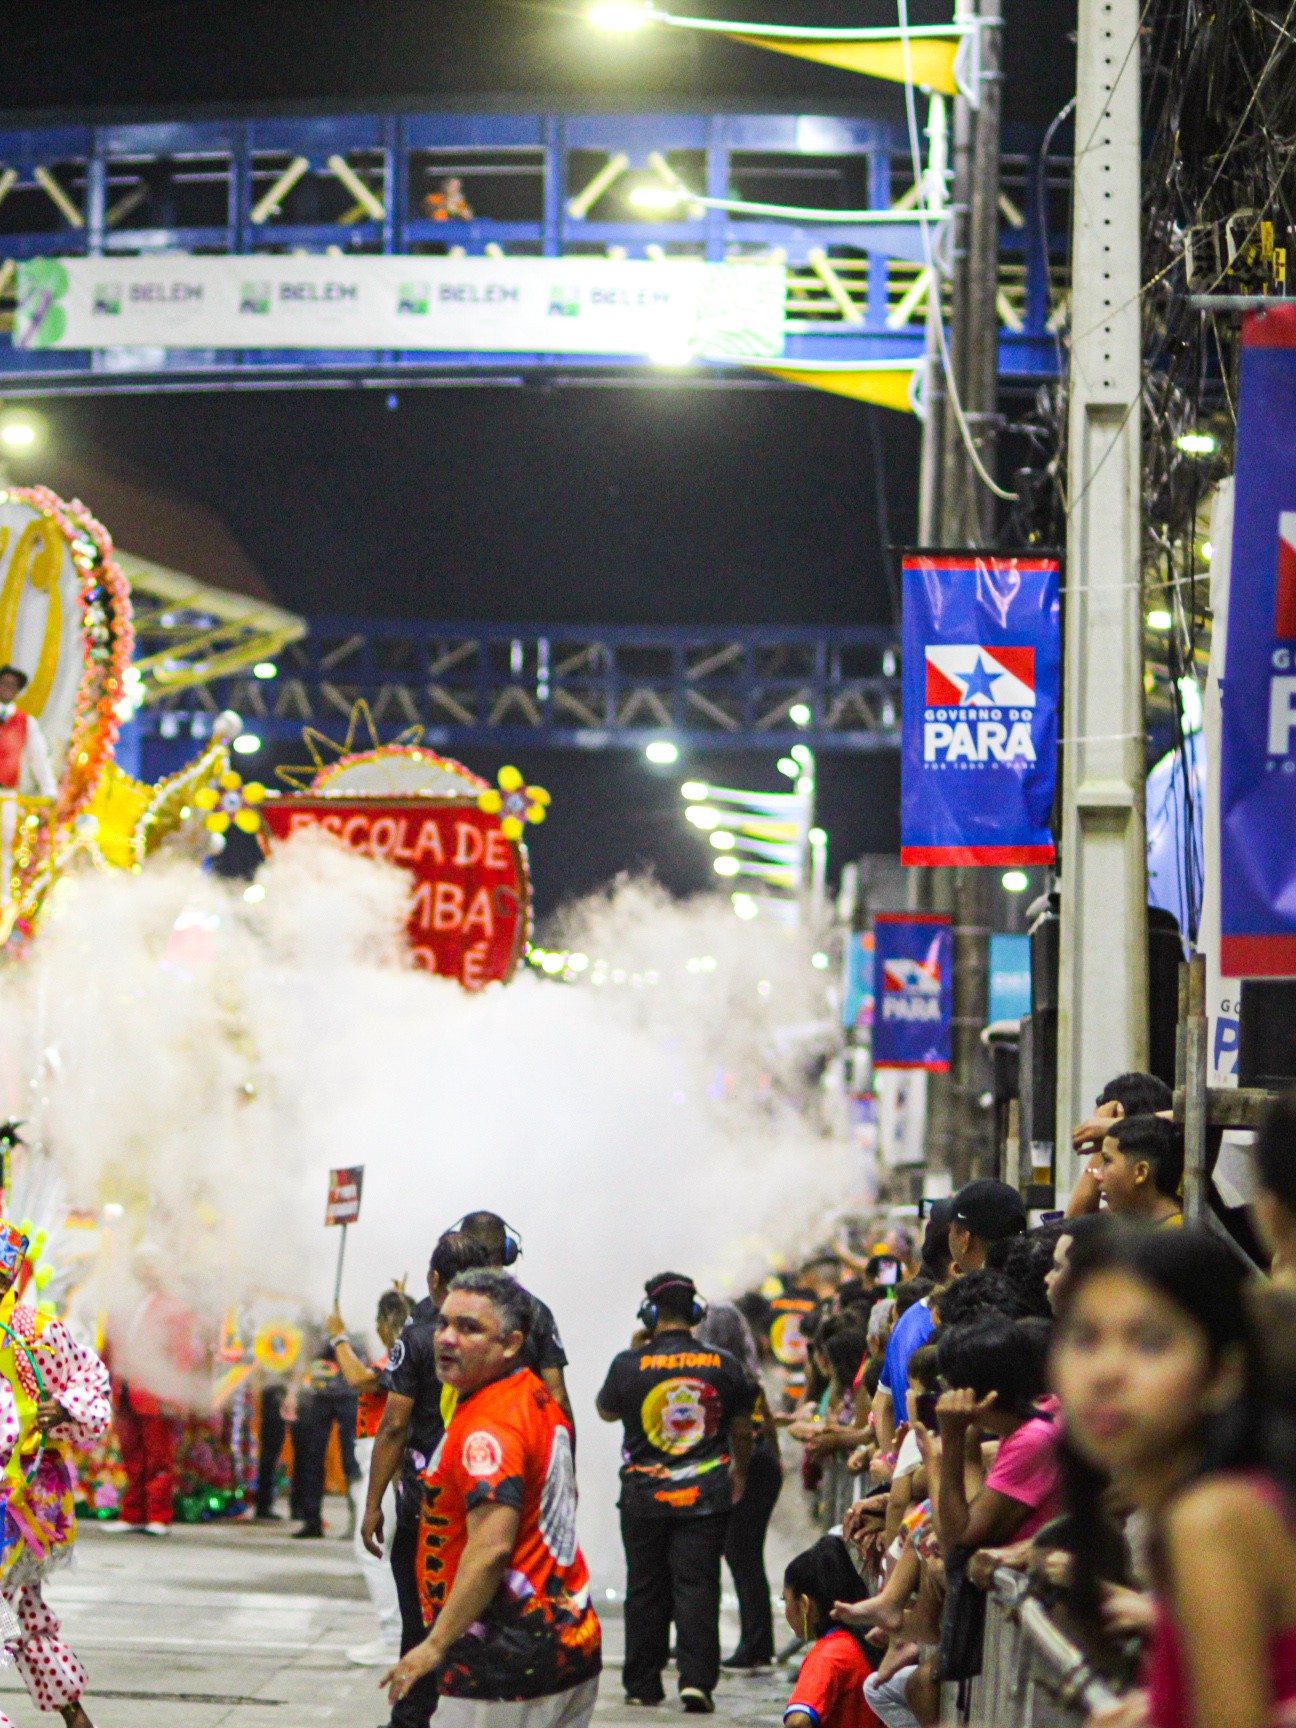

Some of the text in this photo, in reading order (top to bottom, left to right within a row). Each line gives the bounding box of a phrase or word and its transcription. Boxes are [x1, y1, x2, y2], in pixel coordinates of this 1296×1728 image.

[924, 708, 1033, 721] GOVERNO DO
[923, 721, 1037, 763] PARÁ
[454, 823, 509, 869] DE
[463, 943, 490, 989] É
